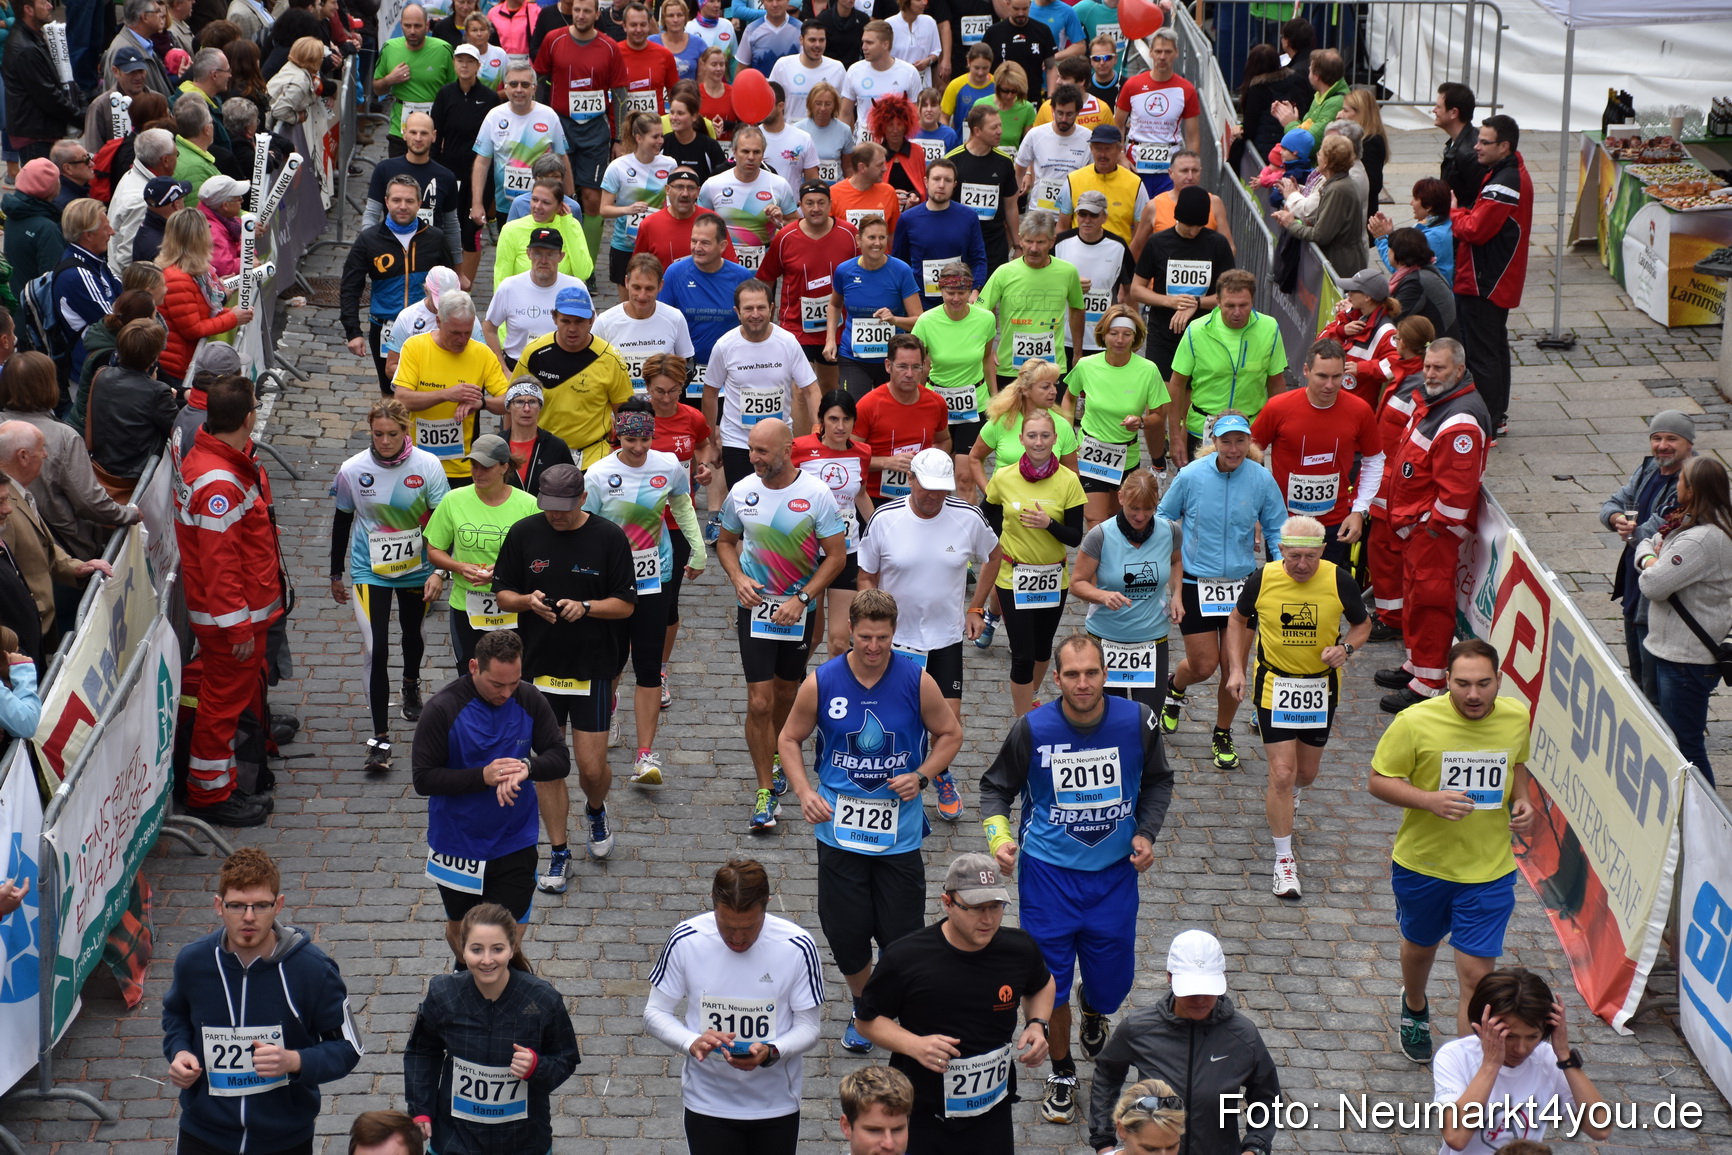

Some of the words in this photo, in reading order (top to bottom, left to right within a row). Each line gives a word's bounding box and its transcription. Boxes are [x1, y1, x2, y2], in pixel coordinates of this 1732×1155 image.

[573, 98, 602, 112] 2473
[626, 99, 654, 112] 2634
[1078, 116, 1102, 124] BÖGL
[1140, 148, 1169, 160] 2223
[254, 140, 266, 187] Laufsport
[277, 172, 293, 197] BMW
[508, 174, 532, 189] 247
[249, 187, 260, 214] BMW
[964, 192, 996, 207] 2412
[1046, 187, 1060, 200] 53
[244, 239, 255, 271] BMW
[738, 255, 759, 268] 661
[1171, 269, 1208, 284] 3005
[240, 271, 253, 310] Laufspor
[1688, 278, 1728, 302] Neumark
[805, 304, 828, 320] 249
[1084, 298, 1108, 312] 056
[856, 328, 892, 342] 2306
[619, 339, 666, 348] www.hasit.de
[1017, 340, 1052, 356] 2384
[628, 362, 642, 377] 25
[737, 362, 782, 370] www.hasit.de
[538, 370, 560, 380] Jürgen
[693, 368, 706, 382] 25
[420, 380, 446, 389] Norbert
[744, 396, 781, 414] 2595
[946, 394, 974, 410] 309
[420, 428, 460, 446] 3052
[1083, 446, 1122, 468] 2347
[886, 470, 907, 485] 20
[1090, 466, 1108, 476] Ingrid
[1293, 484, 1335, 501] 3333
[389, 534, 414, 542] Neumarkt
[381, 541, 414, 562] 274
[390, 563, 408, 572] Ilona
[636, 559, 656, 578] 23
[1018, 574, 1058, 591] 2265
[482, 599, 502, 614] 27
[486, 617, 504, 625] Petra
[764, 624, 792, 634] Thomas
[1106, 652, 1152, 669] 2264
[550, 678, 572, 688] Stefan
[1278, 690, 1324, 709] 2693
[828, 697, 849, 720] 8
[1284, 712, 1316, 724] Wolfgang
[832, 750, 911, 770] FIBALON
[1076, 755, 1108, 764] Neumarkt
[1060, 762, 1116, 788] 2019
[1447, 766, 1502, 788] 2110
[1075, 792, 1103, 801] Simon
[841, 804, 892, 831] 2128
[1050, 801, 1132, 824] FIBALON
[1073, 824, 1110, 832] BASKETS
[1533, 725, 1641, 930] PFLASTERSTEINE
[850, 832, 879, 845] Roland
[980, 870, 994, 884] 85
[702, 1002, 726, 1010] PARTL
[728, 1004, 764, 1012] Neumarkt
[708, 1012, 770, 1038] 3106
[204, 1033, 228, 1041] PARTL
[231, 1032, 268, 1041] Neumarkt
[212, 1044, 266, 1070] 221
[946, 1064, 971, 1072] PARTL
[972, 1054, 1003, 1070] Neumarkt
[454, 1062, 476, 1076] PARTL
[227, 1075, 266, 1086] Markus
[952, 1060, 1007, 1096] 2776
[460, 1074, 522, 1102] 2077
[966, 1094, 997, 1109] Roland
[472, 1105, 504, 1116] Hanna
